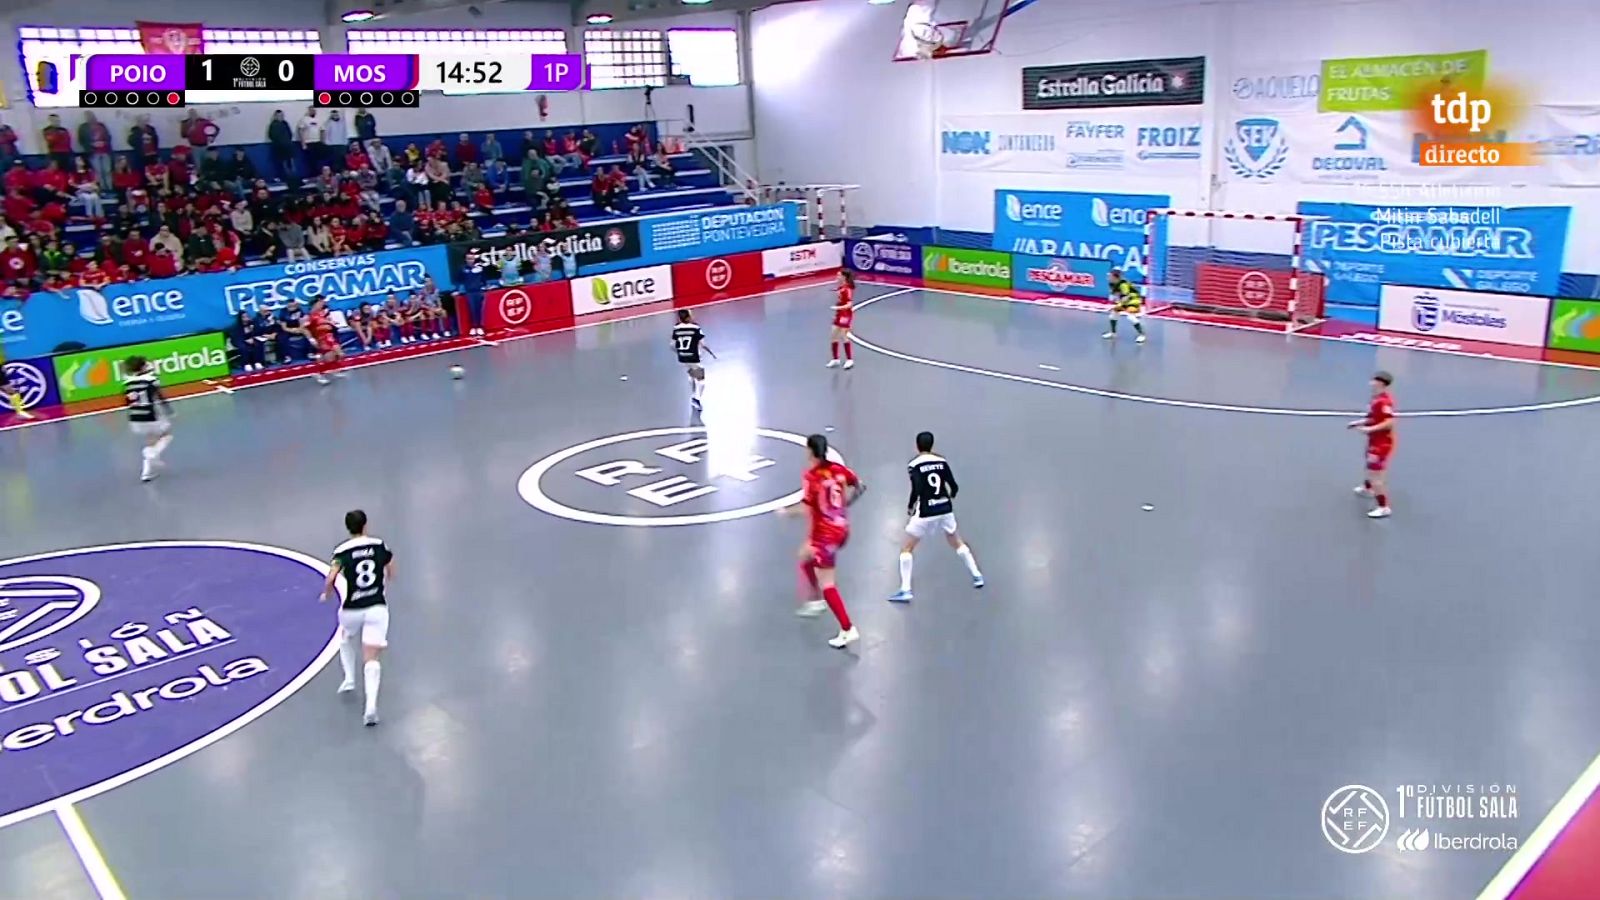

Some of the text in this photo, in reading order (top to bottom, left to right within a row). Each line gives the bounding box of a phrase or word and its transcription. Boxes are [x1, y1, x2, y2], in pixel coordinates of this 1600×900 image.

[1037, 73, 1164, 97] Estrella Galicia
[1327, 87, 1391, 101] FRUTAS
[1066, 124, 1125, 138] FAYFER
[1137, 126, 1200, 147] FROIZ
[1022, 203, 1062, 220] ence
[284, 254, 376, 275] CONSERVAS
[949, 257, 1011, 278] Iberdrola
[224, 261, 426, 315] PESCAMAR
[611, 277, 655, 299] ence
[112, 289, 185, 317] ence
[677, 336, 692, 350] 17
[927, 472, 941, 495] 9
[355, 560, 377, 588] 8
